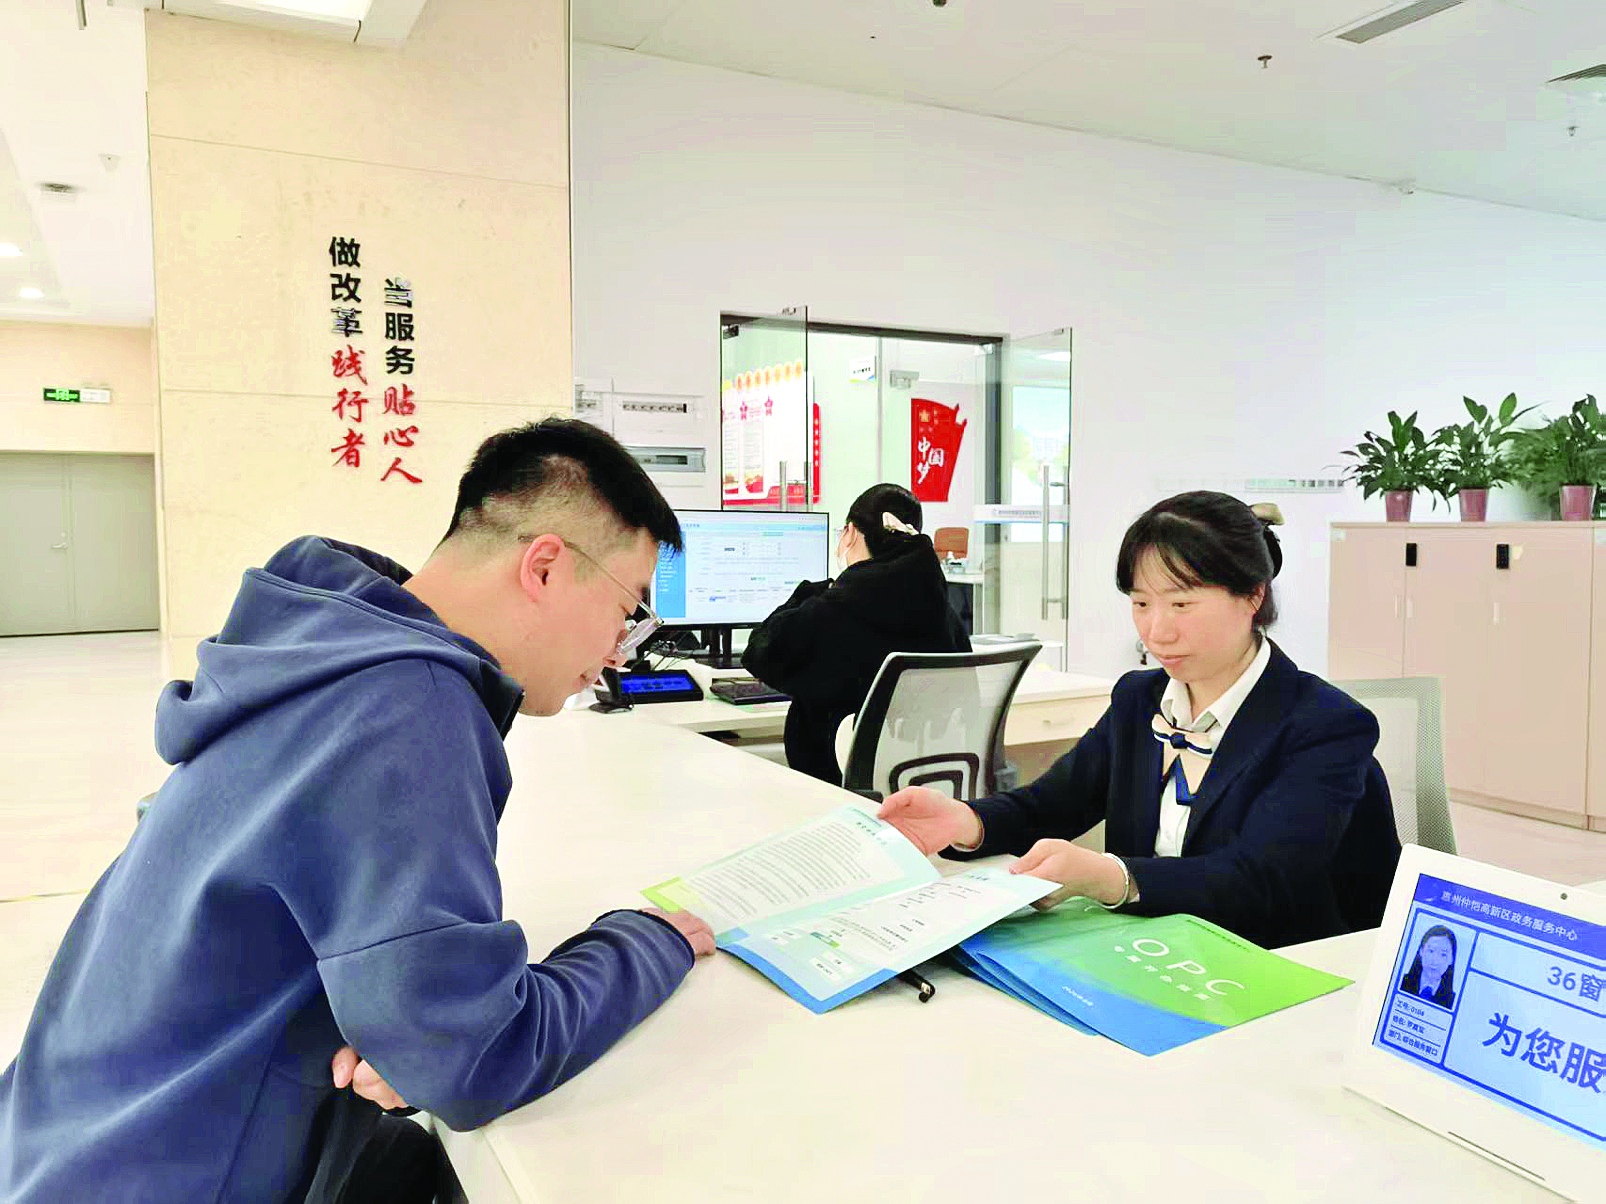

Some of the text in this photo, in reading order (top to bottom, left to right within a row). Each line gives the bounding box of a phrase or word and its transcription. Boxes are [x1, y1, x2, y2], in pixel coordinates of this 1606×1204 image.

[329, 236, 369, 468] 做改革践行者
[381, 275, 422, 484] 当服务贴心人
[1132, 938, 1245, 996] OPC
[1441, 891, 1578, 941] 惠州仲恺高新区政务服务中心
